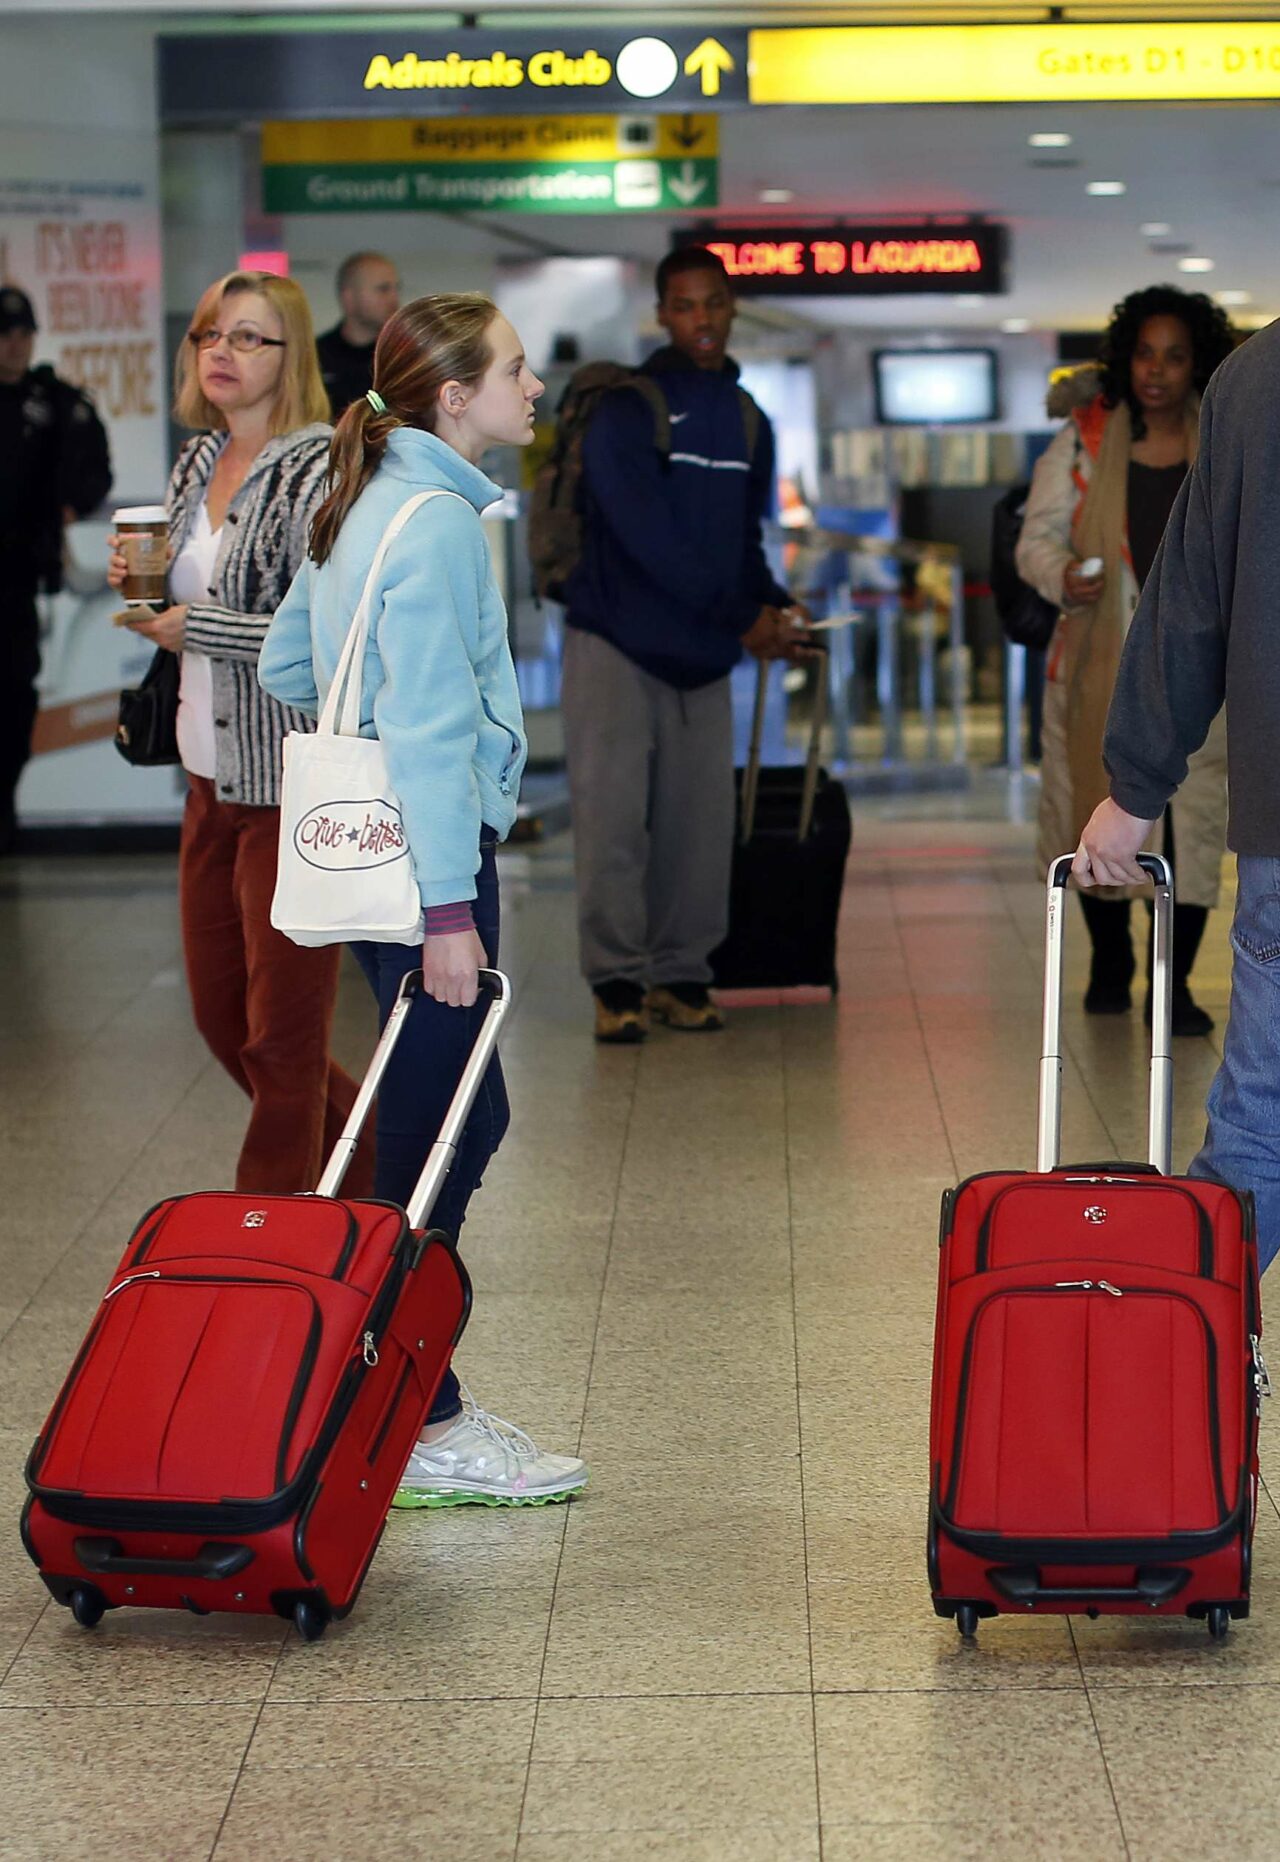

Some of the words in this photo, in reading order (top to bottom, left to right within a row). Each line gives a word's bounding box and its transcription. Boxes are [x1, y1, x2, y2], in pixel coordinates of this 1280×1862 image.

[363, 52, 525, 90] Admirals
[527, 50, 613, 87] Club
[1037, 47, 1131, 75] Gates
[1145, 46, 1187, 74] D1
[413, 125, 527, 149] Baggage
[535, 122, 612, 145] Claim
[307, 173, 408, 202] Ground
[416, 169, 613, 203] Transportation
[706, 242, 804, 276] ELCOME
[810, 241, 847, 275] TO
[852, 239, 982, 274] LAGUARDIA
